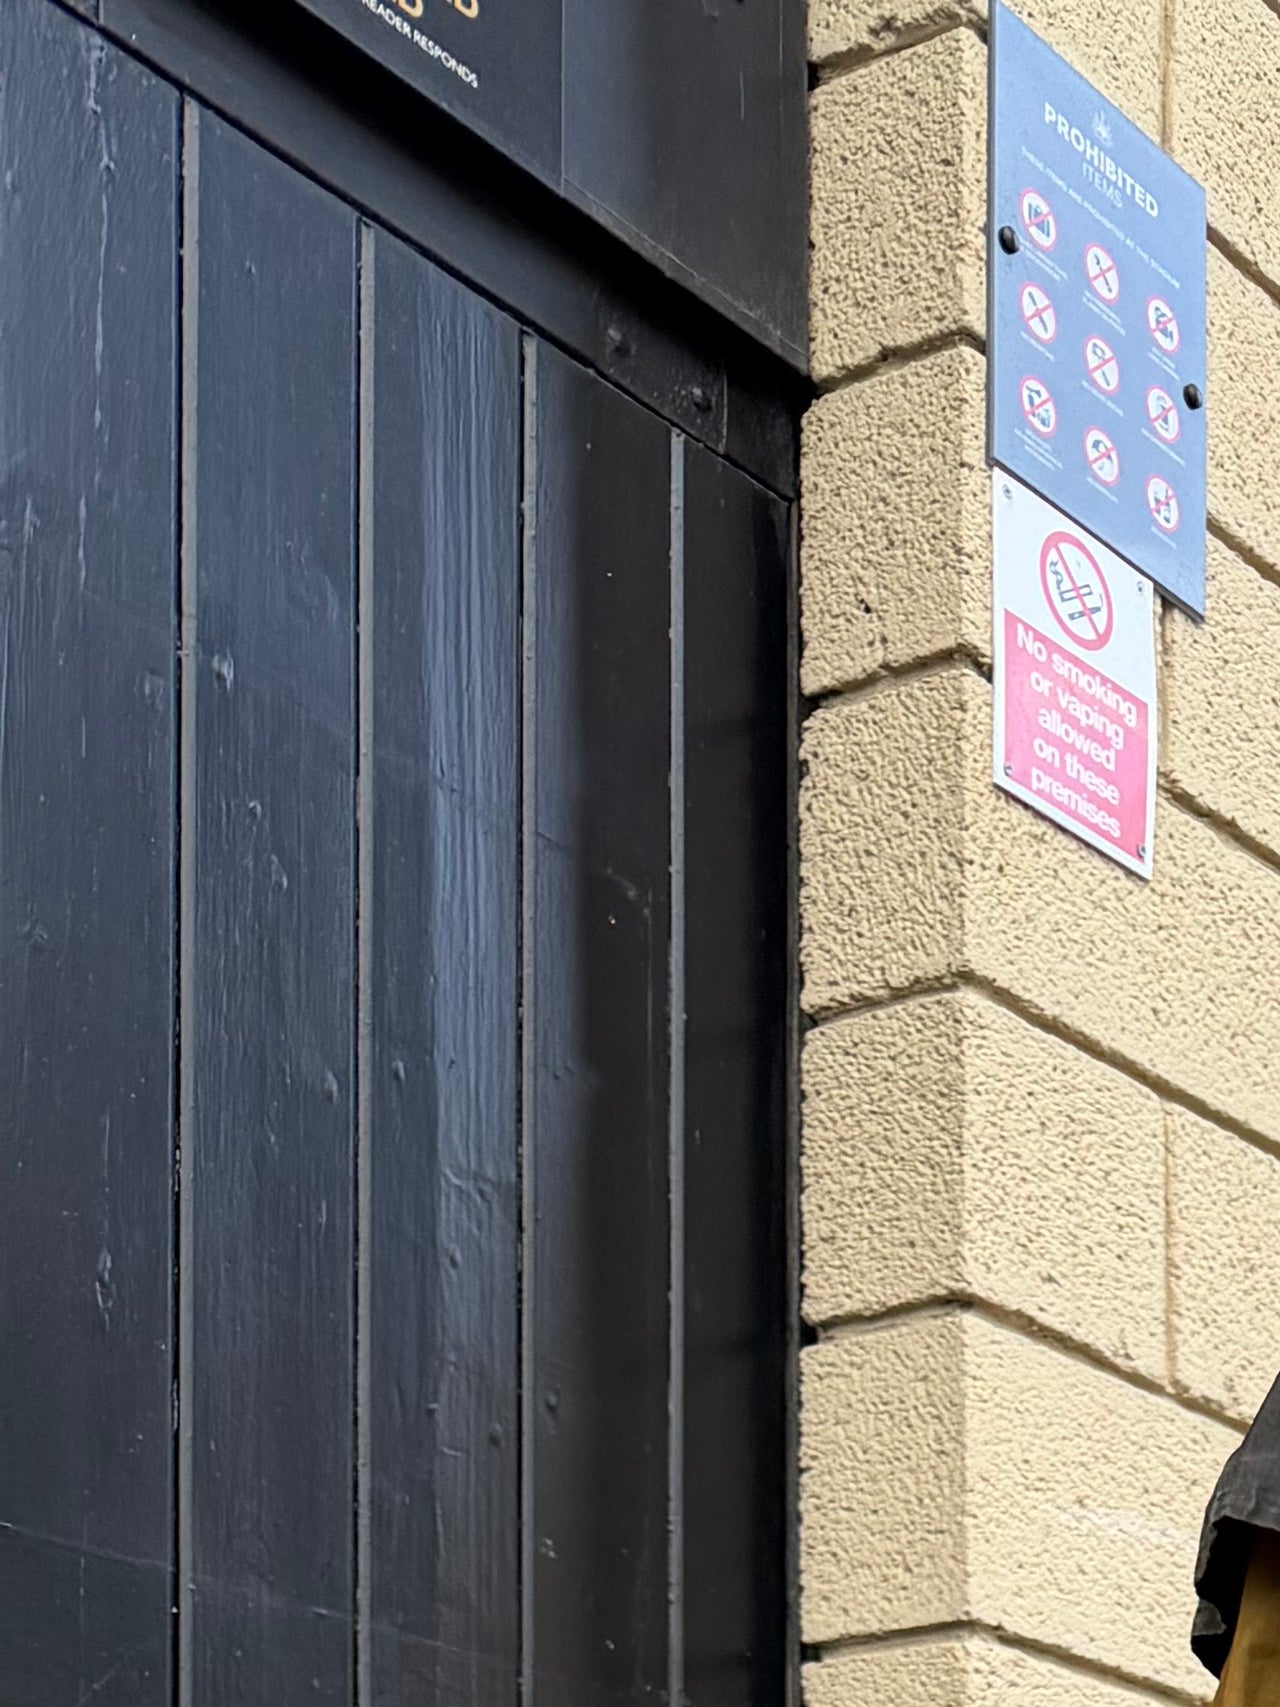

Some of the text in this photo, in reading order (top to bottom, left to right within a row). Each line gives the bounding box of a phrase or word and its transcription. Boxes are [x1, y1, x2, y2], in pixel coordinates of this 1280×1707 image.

[413, 29, 478, 88] RESPONDS
[1044, 102, 1159, 217] PROHIBITED
[1083, 161, 1123, 208] ITEMS
[1017, 623, 1137, 728] No smoking
[1031, 672, 1124, 750] or vaping
[1038, 709, 1115, 772] allowed
[1031, 767, 1120, 838] premises
[1033, 738, 1119, 806] on these
